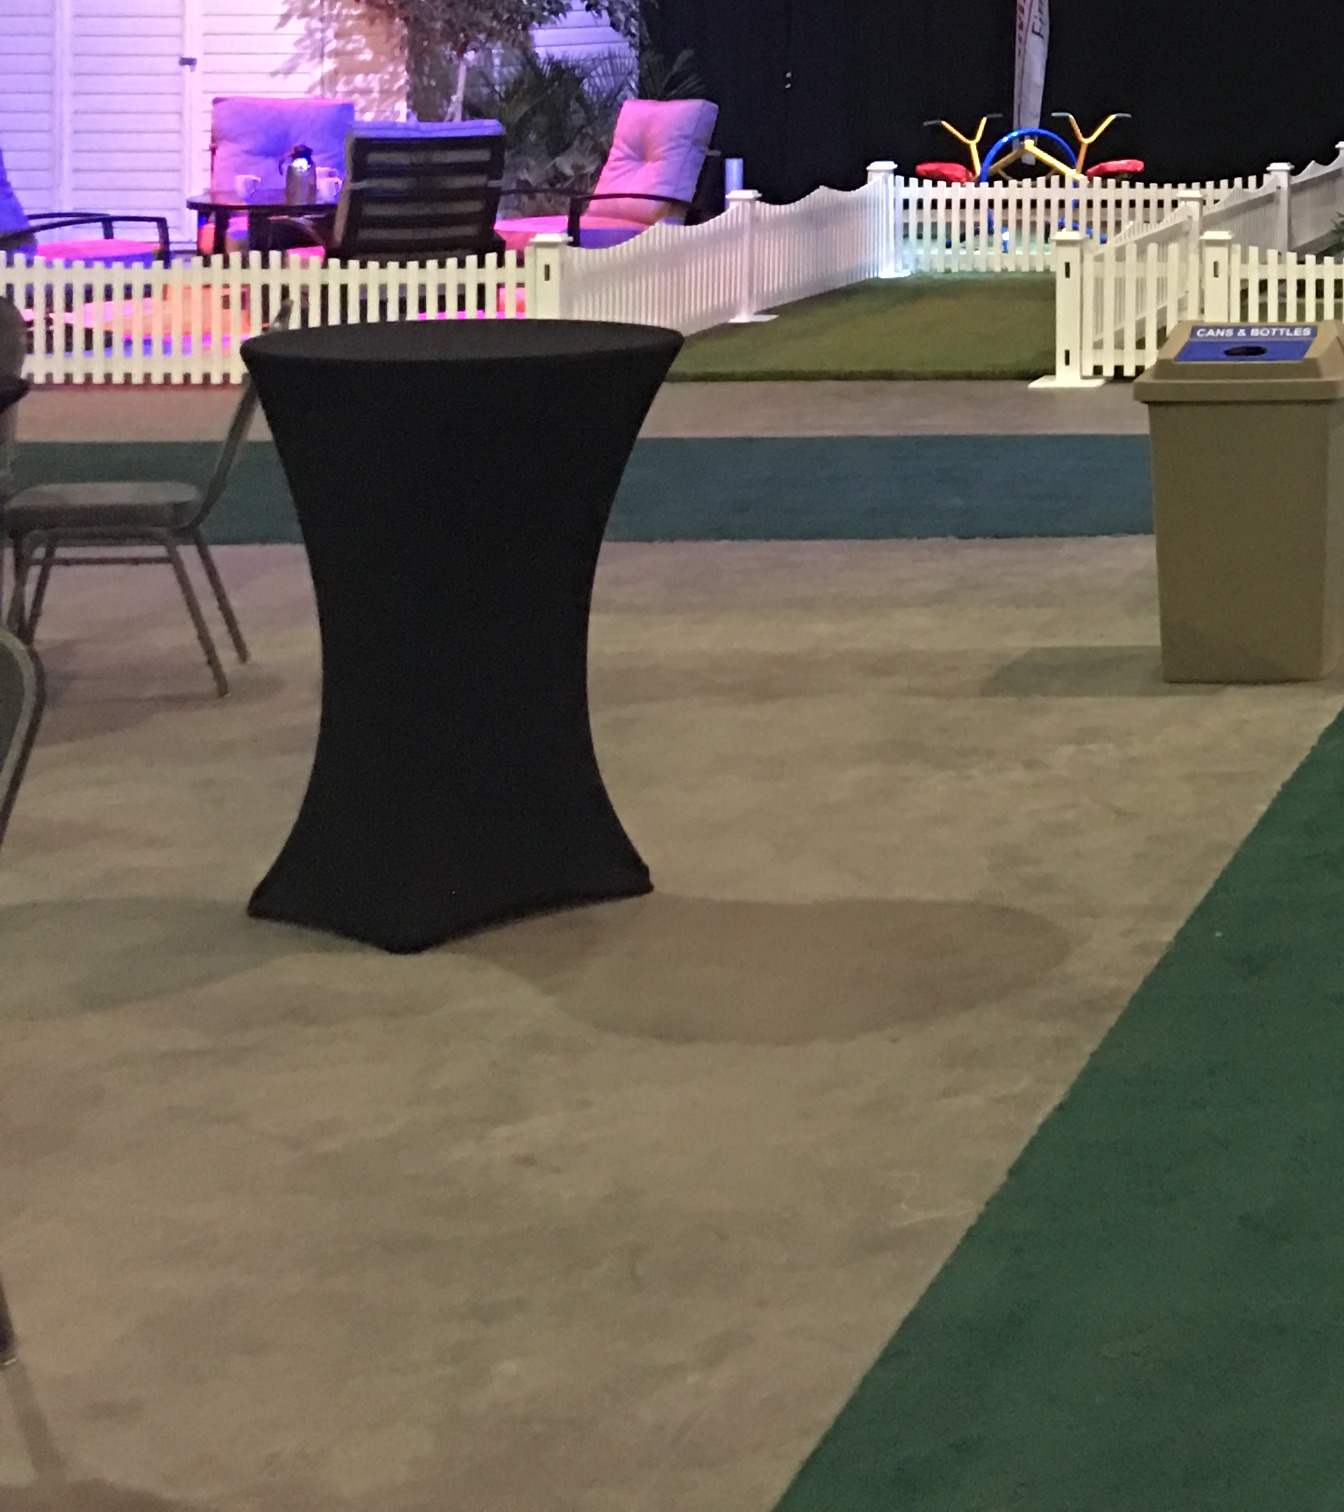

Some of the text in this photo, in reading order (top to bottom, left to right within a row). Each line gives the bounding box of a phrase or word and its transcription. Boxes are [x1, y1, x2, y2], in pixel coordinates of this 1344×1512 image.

[1196, 327, 1312, 338] CANS & BOTTLES
